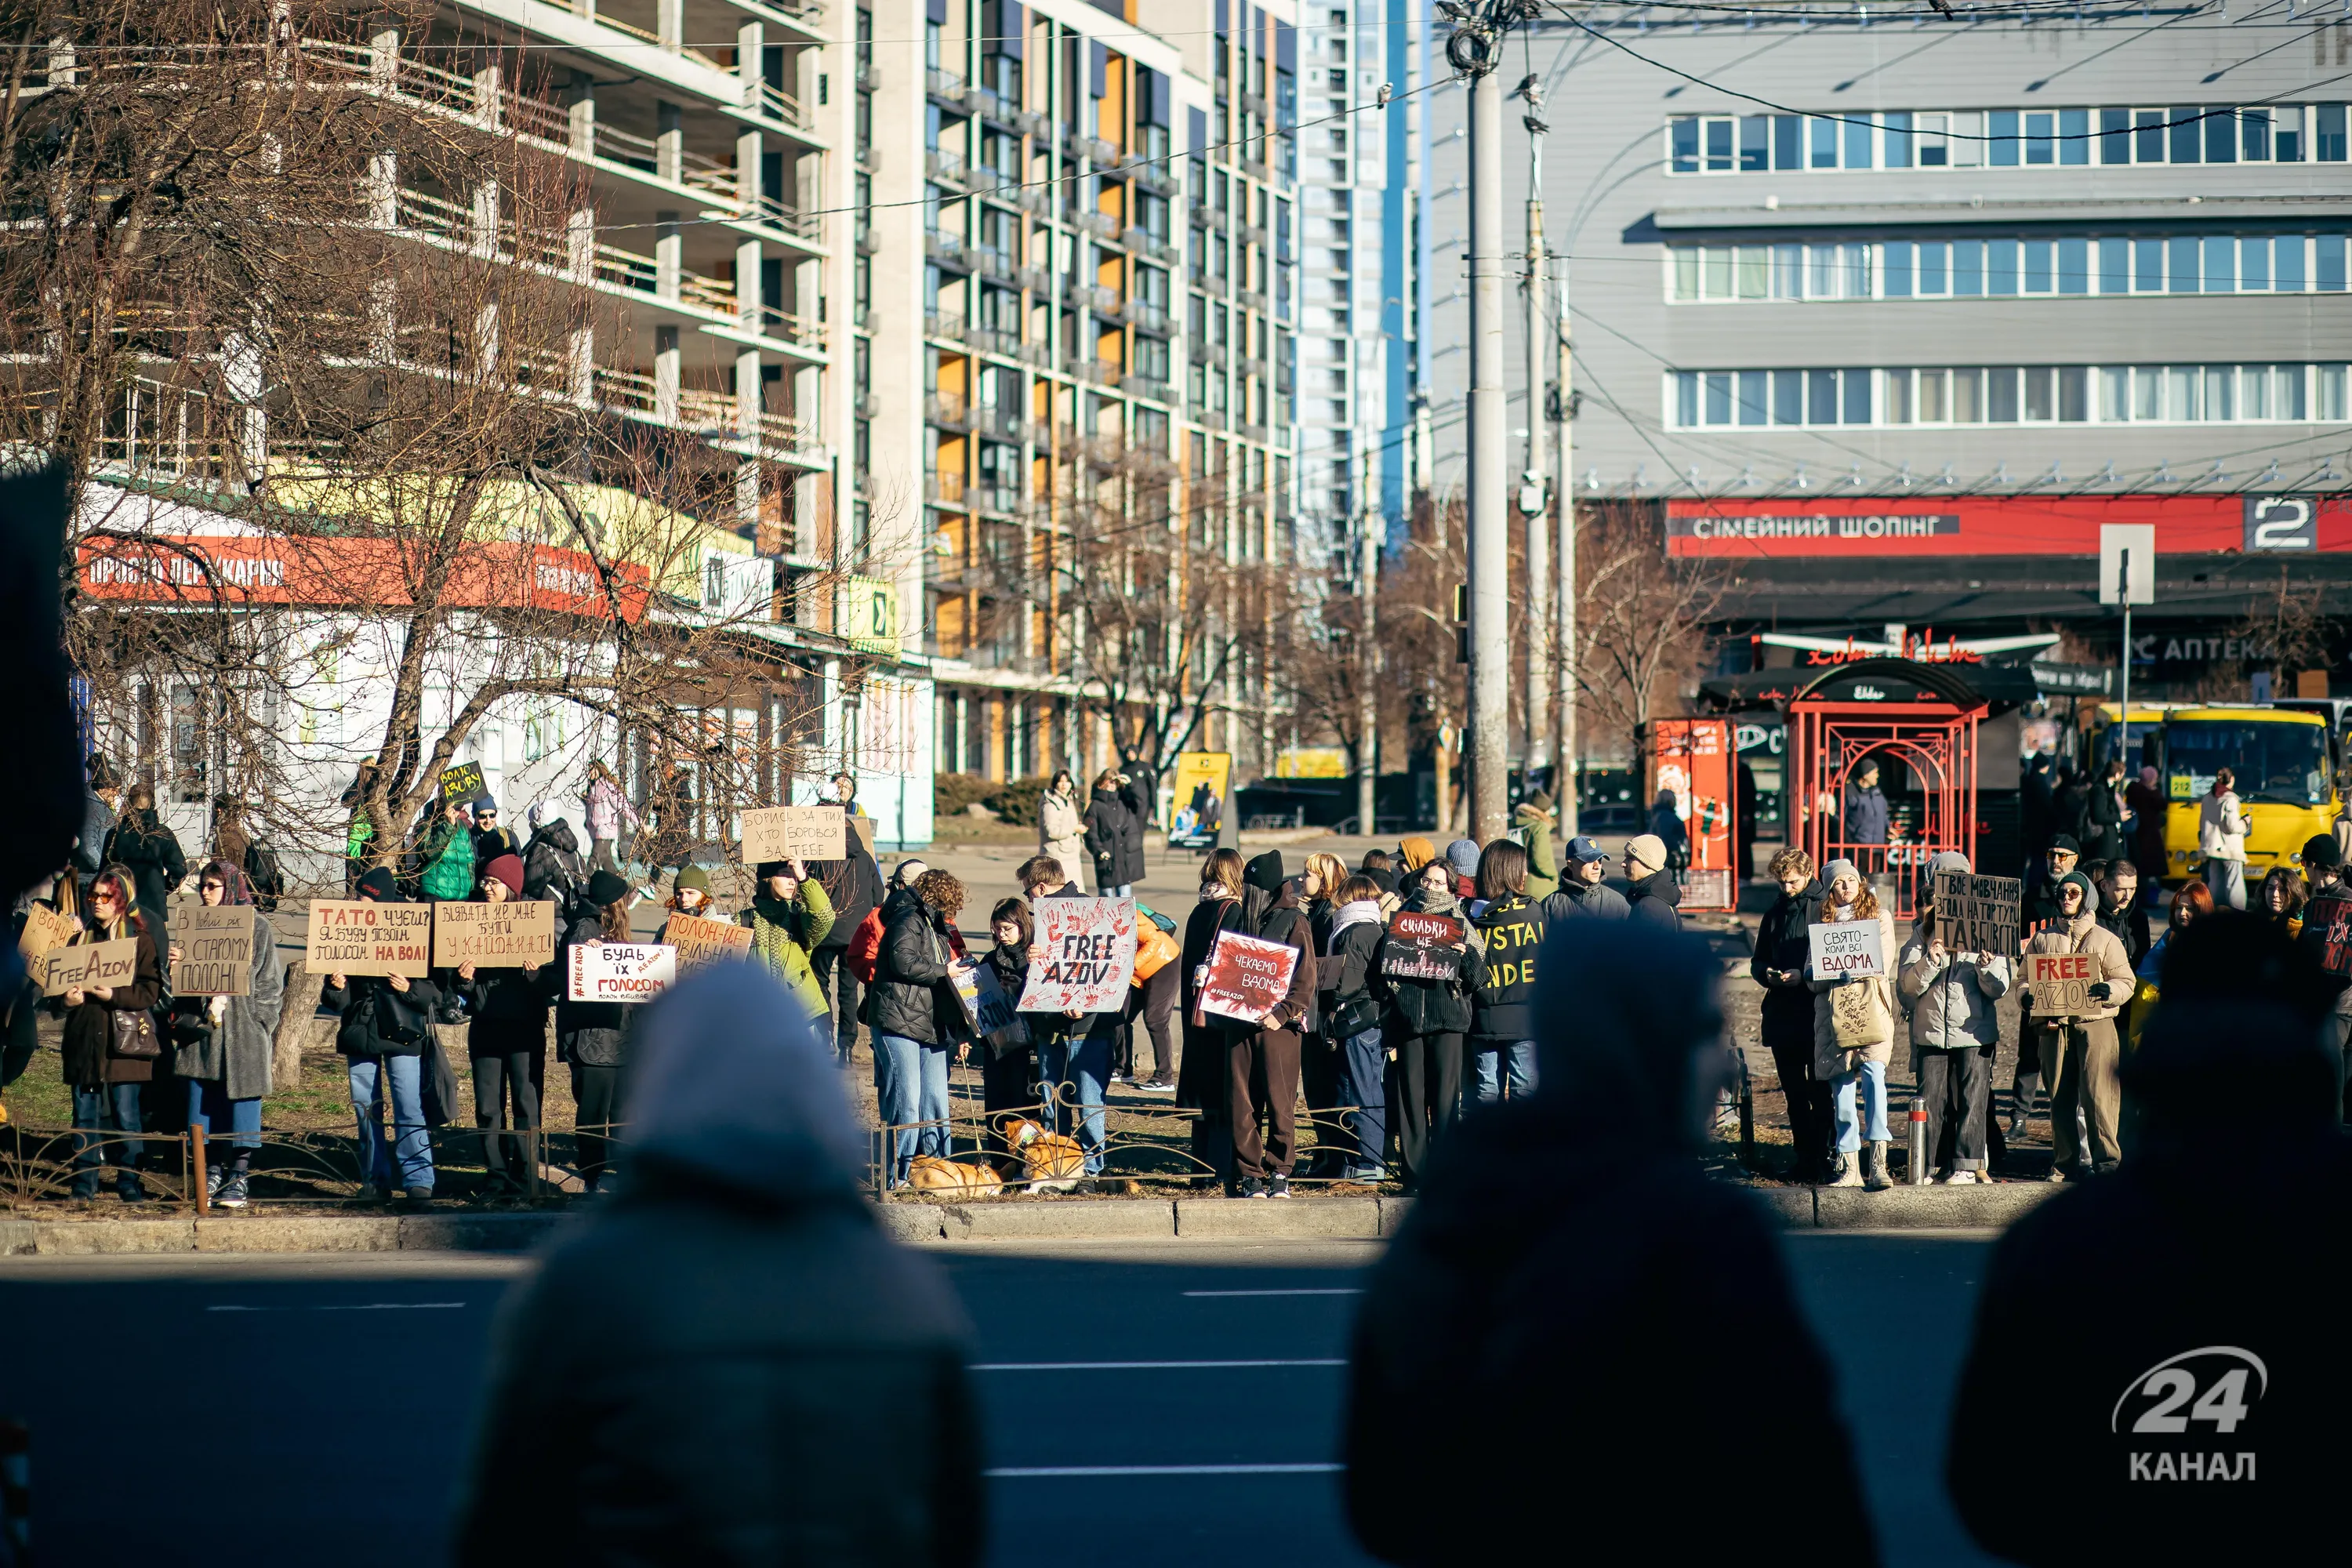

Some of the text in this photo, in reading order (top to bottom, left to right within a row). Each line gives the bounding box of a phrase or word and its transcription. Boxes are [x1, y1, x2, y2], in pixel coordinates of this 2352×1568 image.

[1692, 513, 1940, 539] СІМЕЙНИЙ ШОПІНГ
[2254, 496, 2310, 548] 2
[440, 765, 470, 784] ВОЛЮ
[445, 772, 481, 800] АЗОВУ
[743, 811, 793, 828] БОРИСЬ
[802, 811, 815, 822] ЗА
[756, 826, 837, 844] ХТО БОРОВСЯ
[763, 844, 824, 858] ЗА ТЕБЕ
[1970, 877, 2020, 903] МОВЧАННЯ
[318, 908, 430, 927] ТАТО, ЧУЄШ?
[441, 904, 488, 922] ВІДВАГА
[513, 902, 536, 920] МАЄ
[1936, 897, 1964, 918] ЗГОДА
[38, 911, 68, 942] ВОНИ
[178, 909, 241, 935] В Новий рік
[477, 920, 513, 935] БУТИ
[1399, 918, 1447, 938] СКІЛЬКИ
[319, 926, 333, 941] Я
[335, 927, 367, 943] БУДУ
[1416, 935, 1433, 949] ЩЕ
[1936, 916, 1969, 951] ТА
[177, 938, 249, 962] В СТАРОМУ
[376, 946, 395, 961] НА
[398, 946, 426, 961] ВОЛІ
[446, 936, 457, 957] У
[602, 948, 645, 961] БУДЬ
[1062, 935, 1116, 960] FREE
[1825, 943, 1862, 954] КОЛИ ВСІ
[612, 963, 630, 975] ЇХ
[1235, 954, 1277, 975] ЧЕКАЄМО
[1388, 965, 1456, 978] FREE AZOV
[1822, 953, 1874, 971] ВДОМА
[2036, 957, 2090, 981] FREE
[180, 963, 237, 991] ПОЛОНІ
[1040, 961, 1110, 985] AZOV
[1241, 974, 1279, 990] ВДОМА
[597, 978, 666, 993] ГОЛОСОМ
